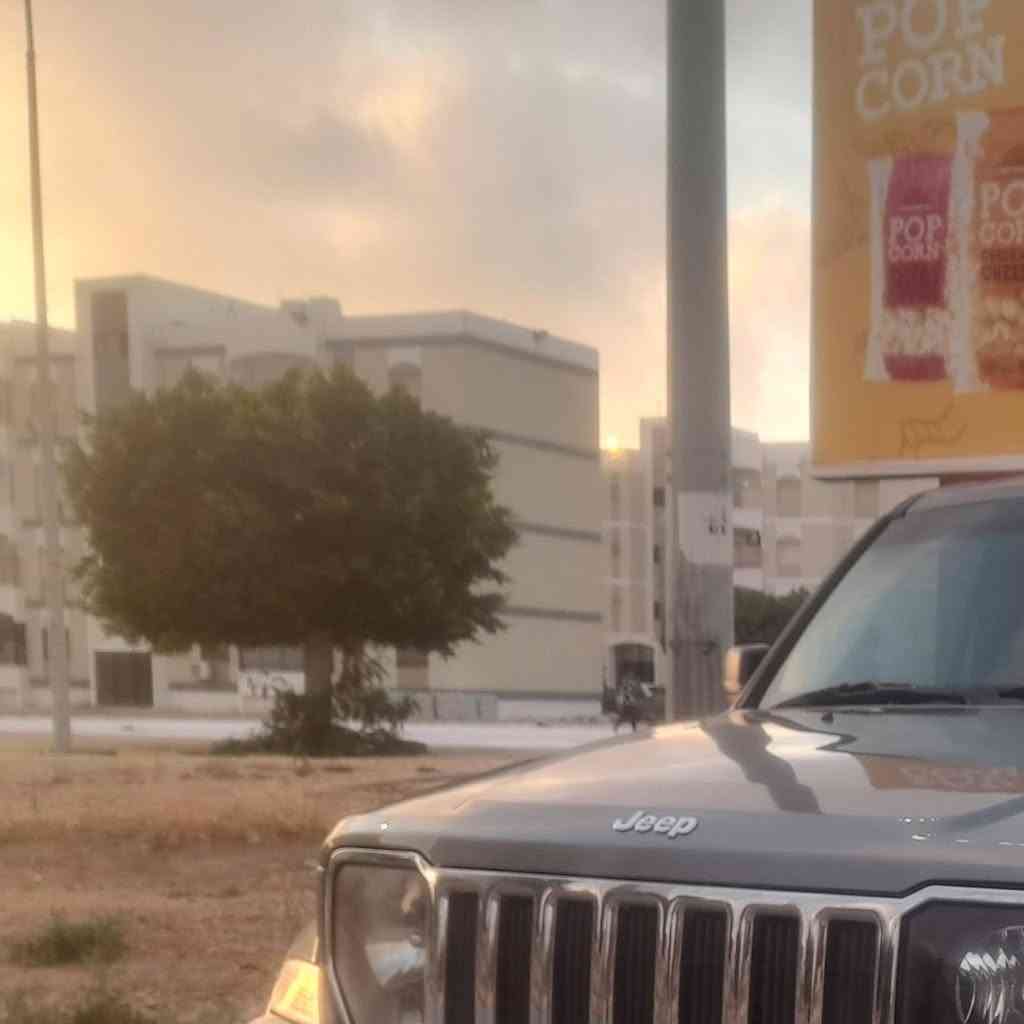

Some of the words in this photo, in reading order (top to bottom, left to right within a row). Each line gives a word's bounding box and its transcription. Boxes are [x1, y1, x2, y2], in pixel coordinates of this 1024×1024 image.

[856, 32, 1008, 122] CORN
[888, 214, 943, 244] POP
[888, 241, 942, 261] CORN
[612, 811, 699, 840] Jeep
